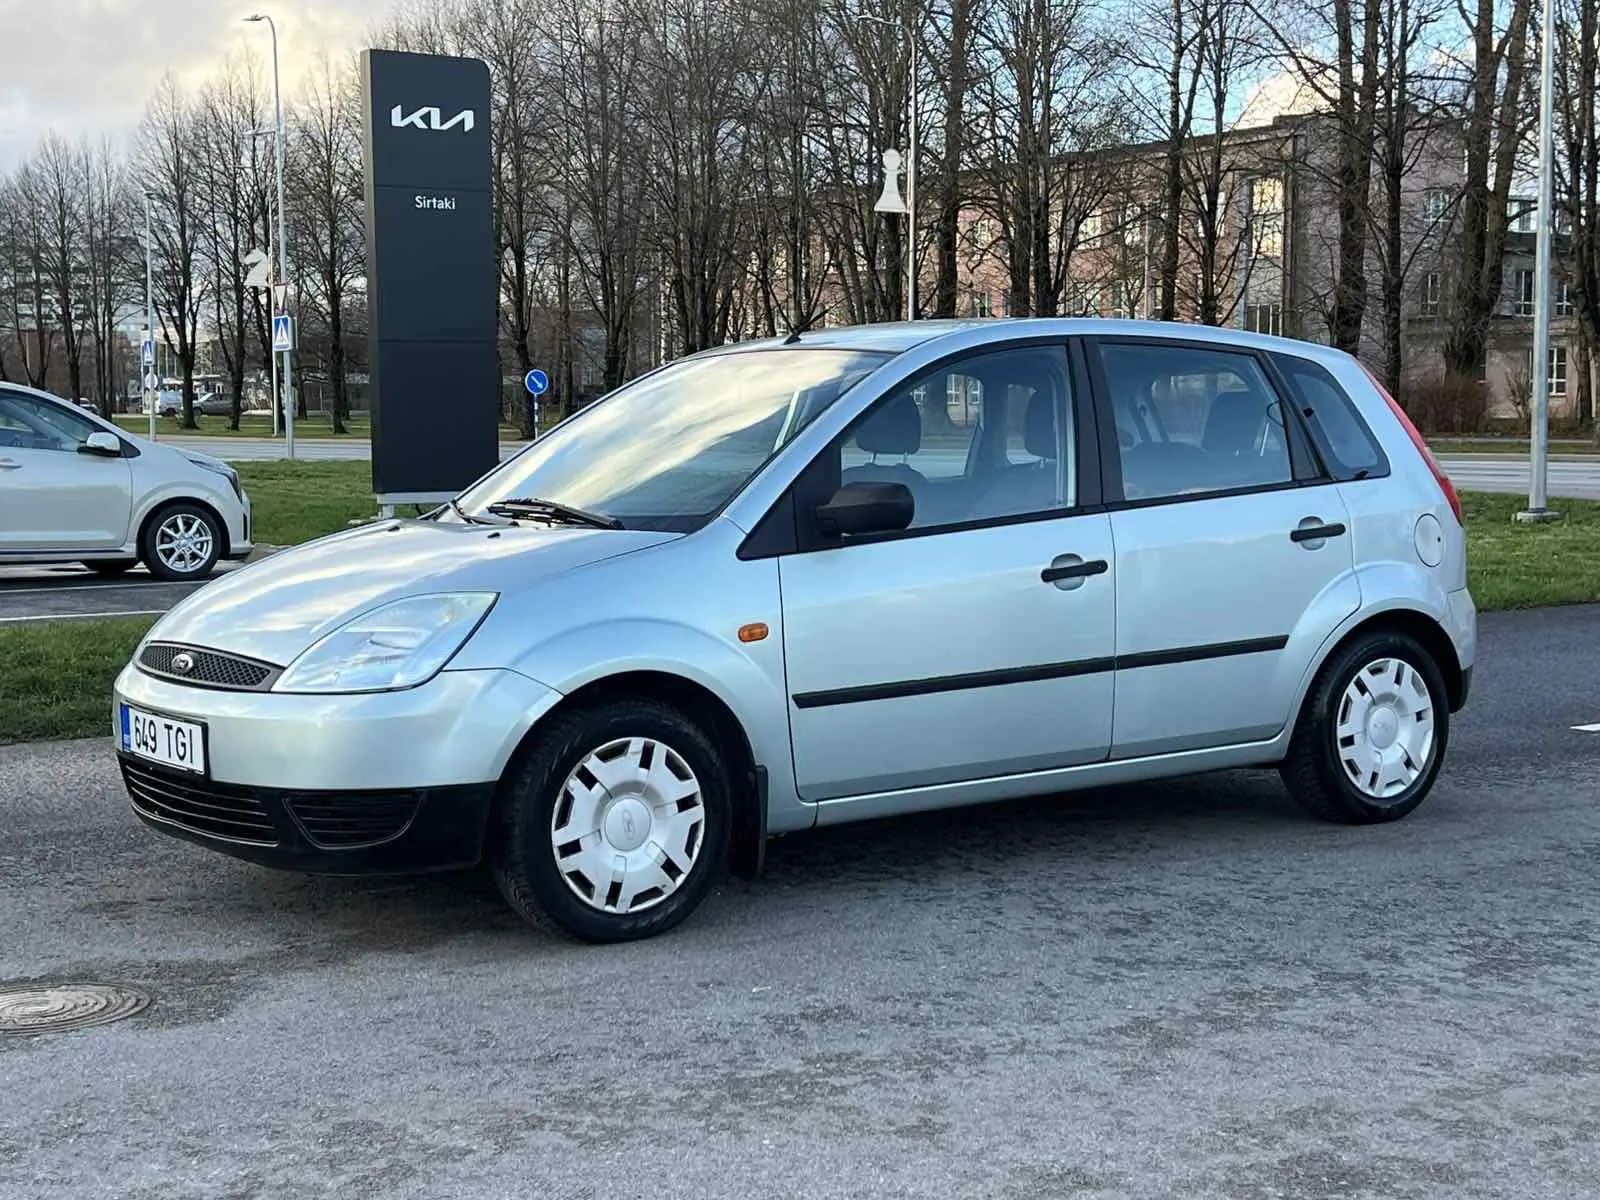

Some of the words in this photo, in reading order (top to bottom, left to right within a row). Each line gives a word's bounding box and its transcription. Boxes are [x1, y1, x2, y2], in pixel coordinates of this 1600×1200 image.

[391, 104, 474, 132] KIA
[415, 195, 456, 210] Sirtaki
[134, 715, 157, 754] 649
[164, 723, 193, 764] TGI
